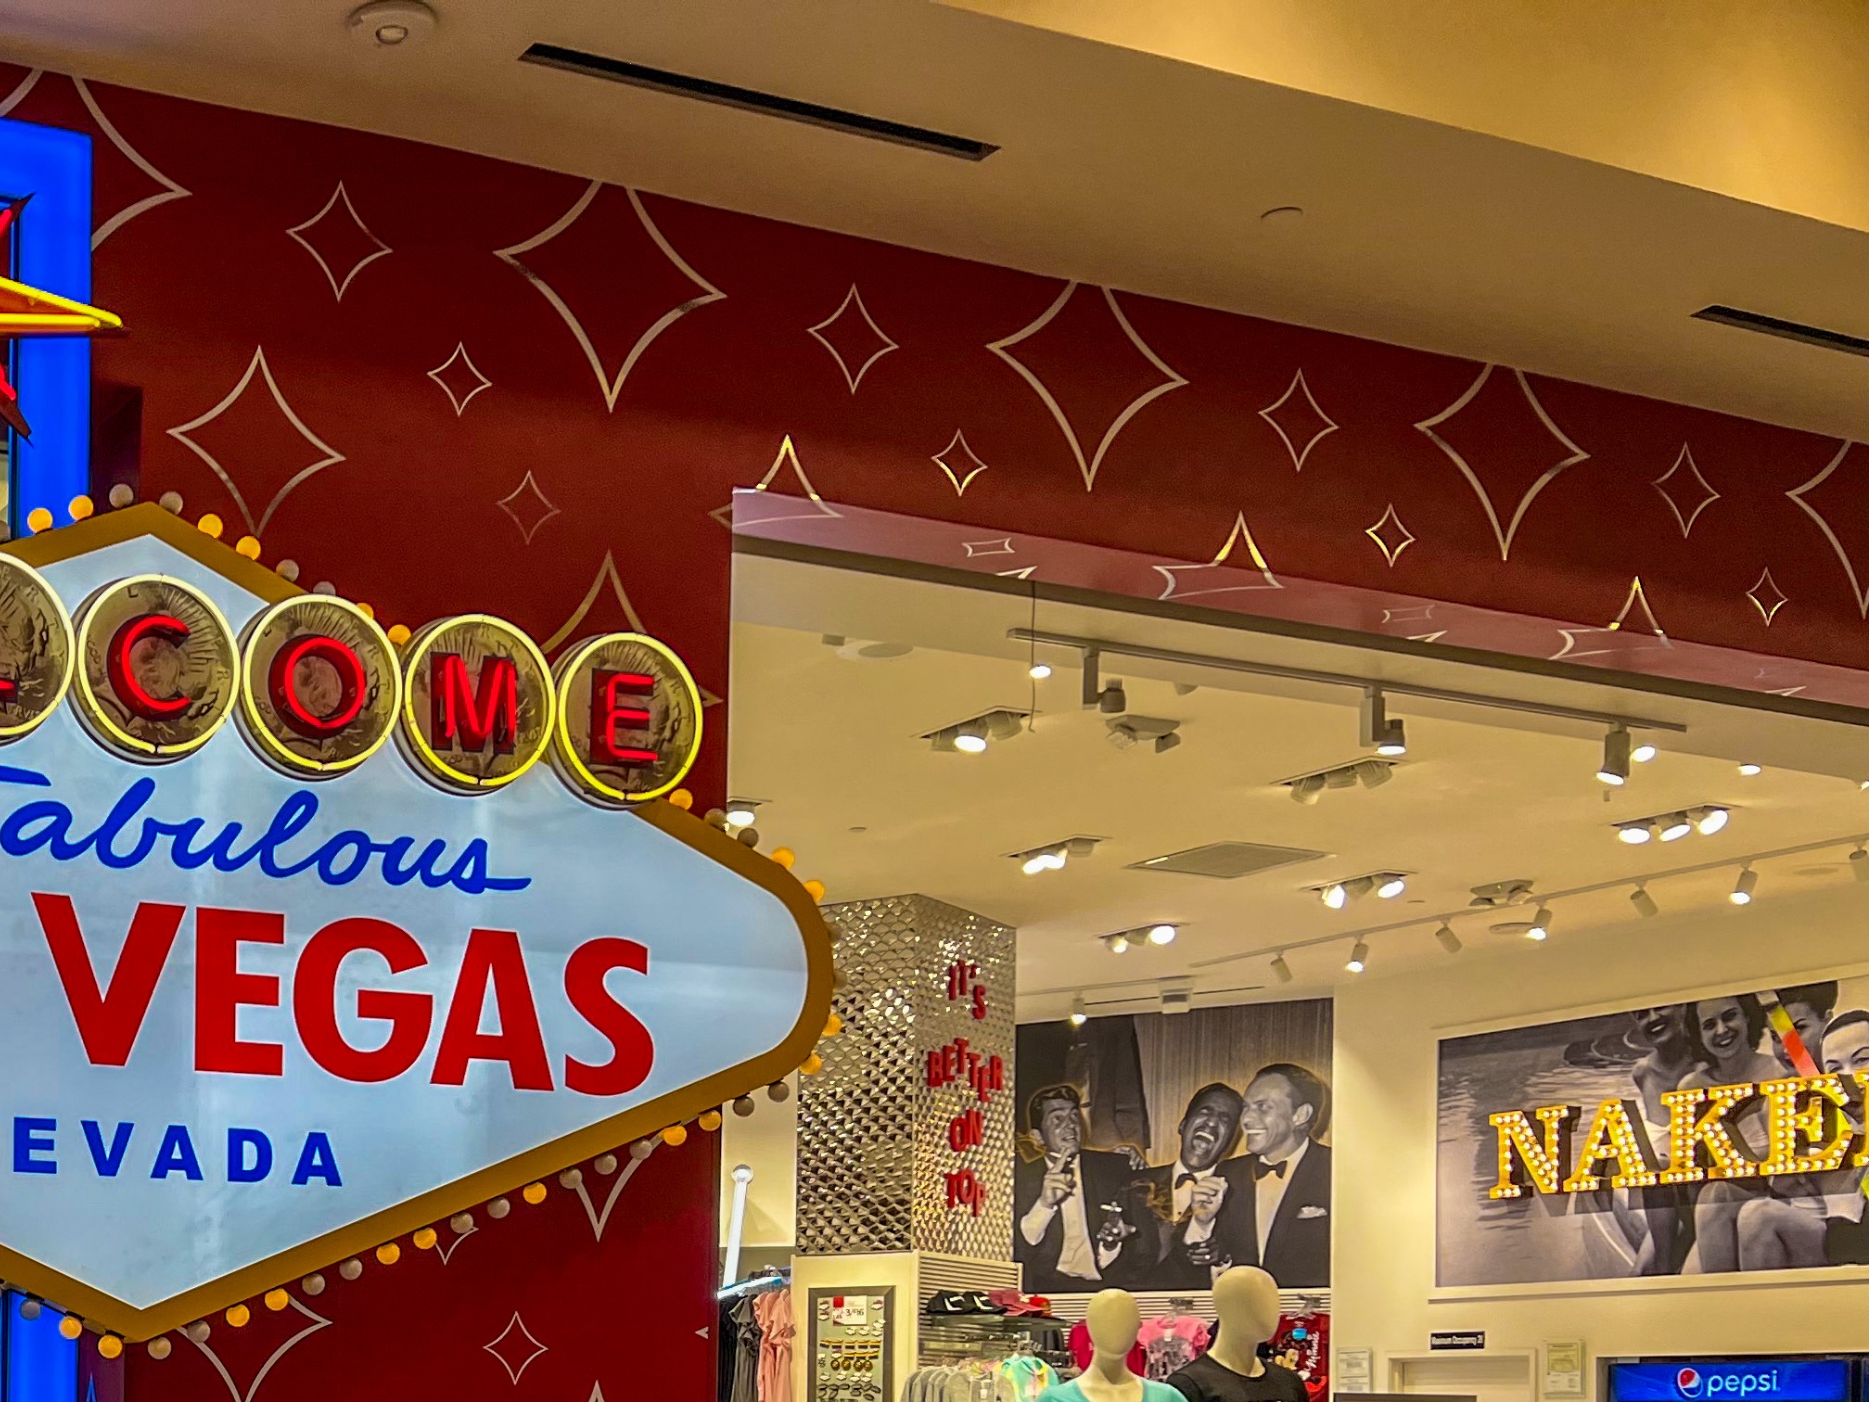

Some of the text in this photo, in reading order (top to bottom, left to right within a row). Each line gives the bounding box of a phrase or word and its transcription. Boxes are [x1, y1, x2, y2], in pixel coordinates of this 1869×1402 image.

[31, 890, 654, 1096] VEGAS
[927, 1037, 1004, 1103] BETTER
[949, 1108, 984, 1152] ON
[1488, 1066, 1869, 1200] NAKE
[943, 1168, 987, 1218] TOP
[1706, 1369, 1778, 1397] pepsi
